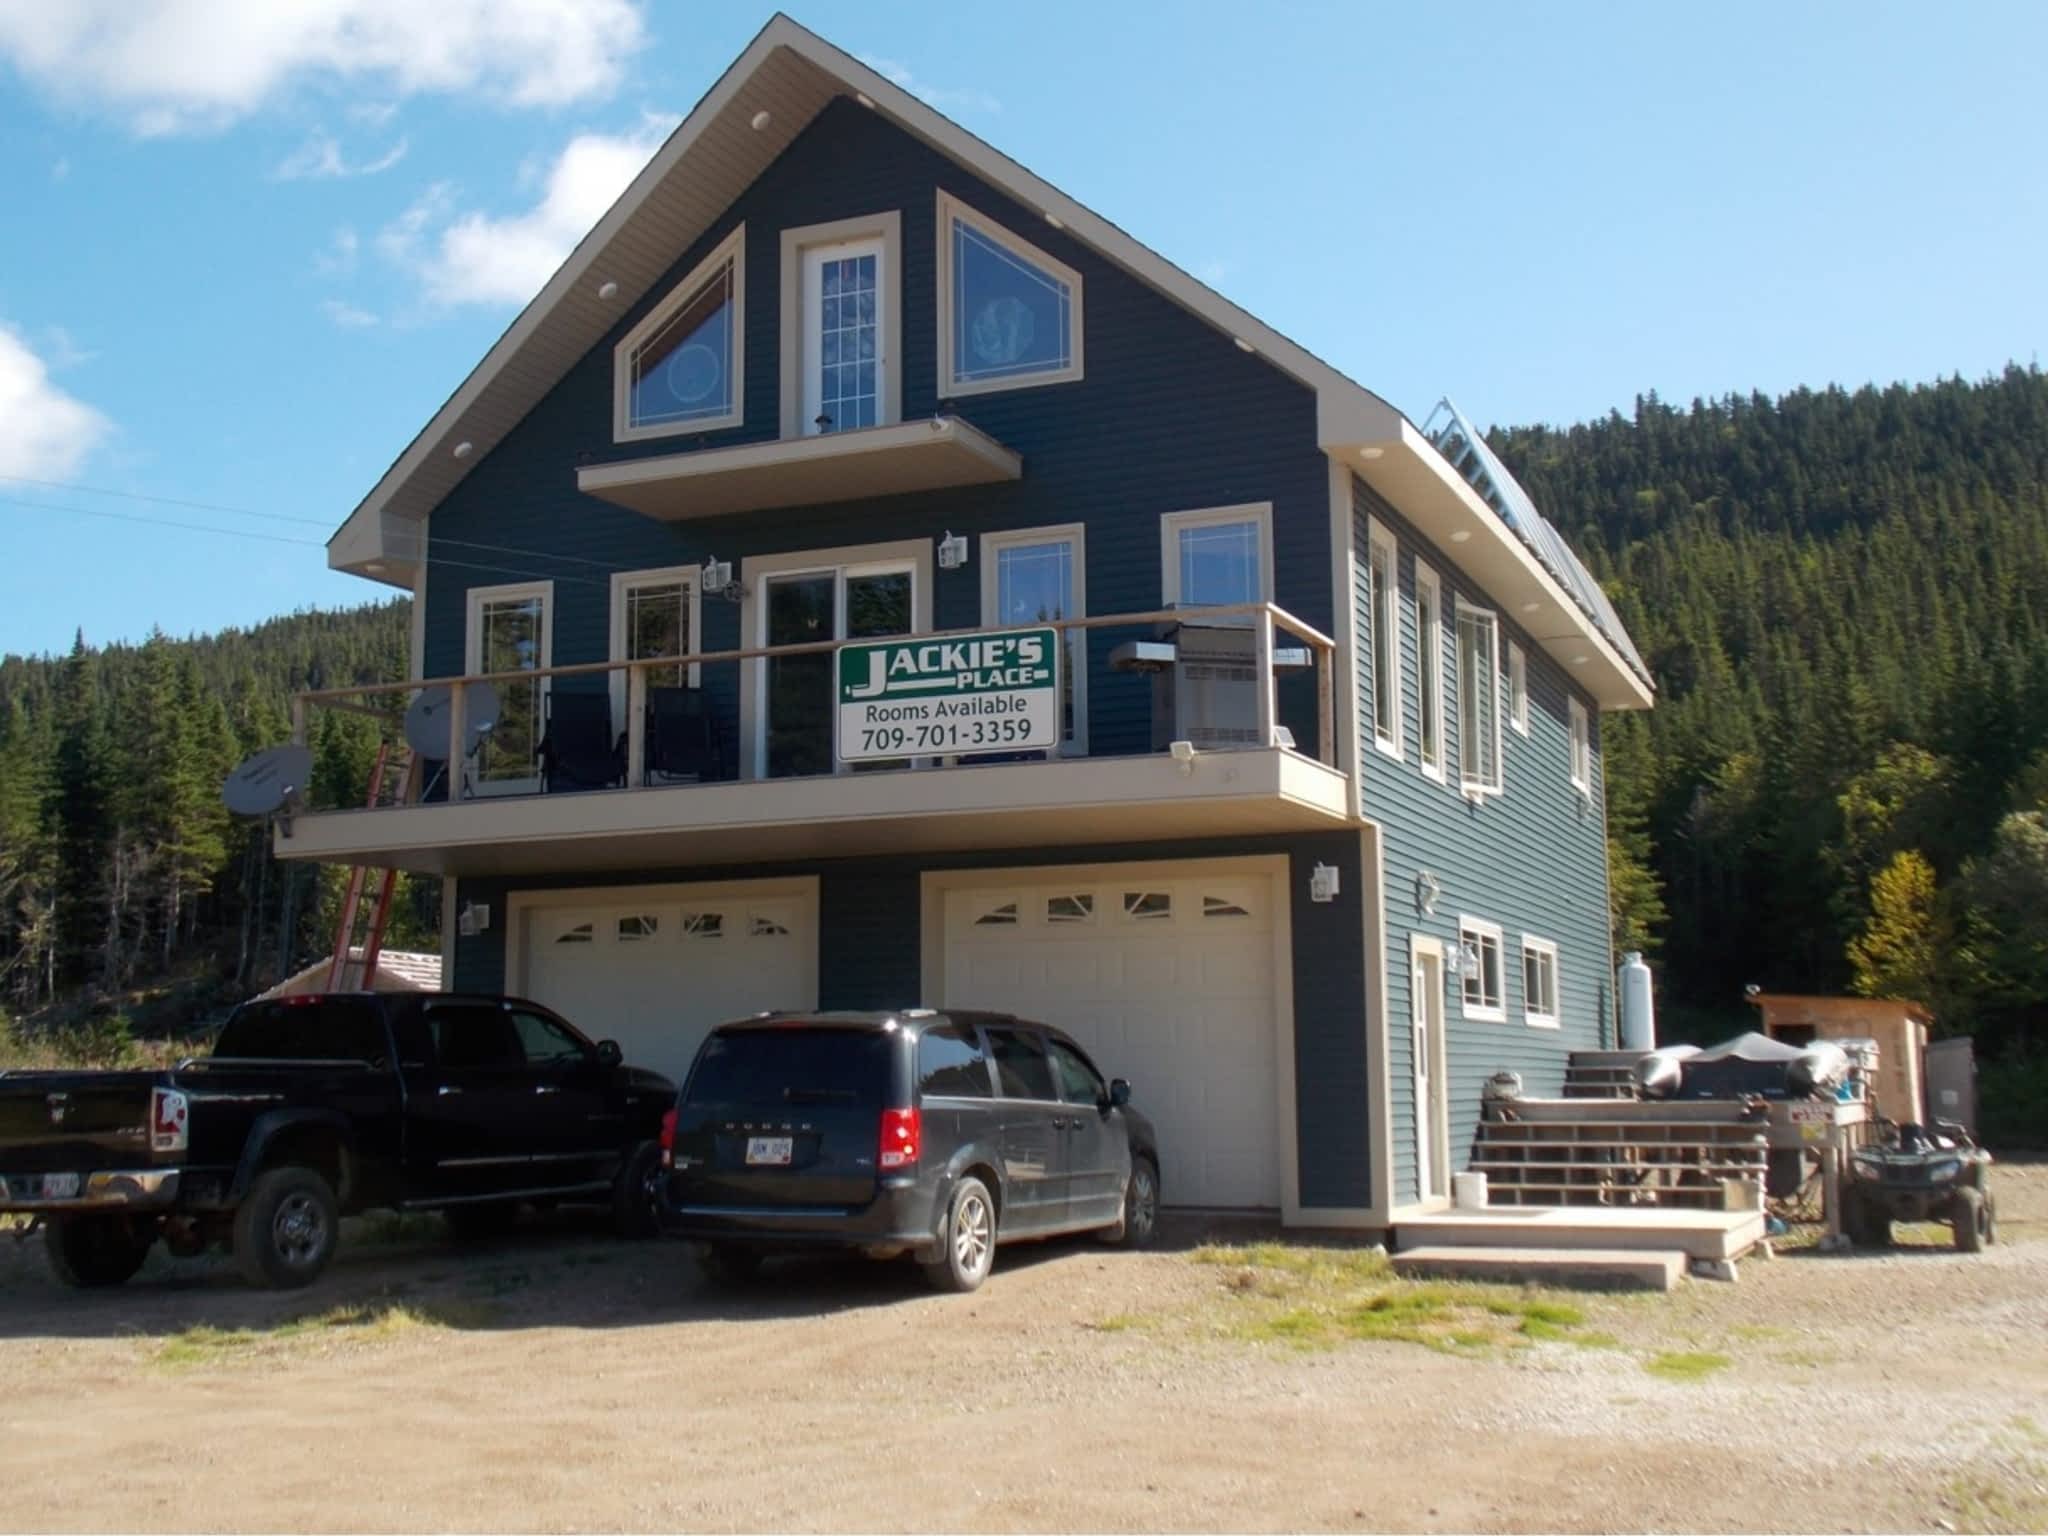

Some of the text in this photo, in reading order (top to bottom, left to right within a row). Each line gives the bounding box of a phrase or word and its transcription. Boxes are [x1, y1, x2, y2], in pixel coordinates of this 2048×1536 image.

[850, 637, 1042, 697] JACKIE'S
[957, 667, 1034, 689] PLACE
[866, 695, 1027, 723] Rooms Available
[861, 718, 1032, 751] 709-701-3359
